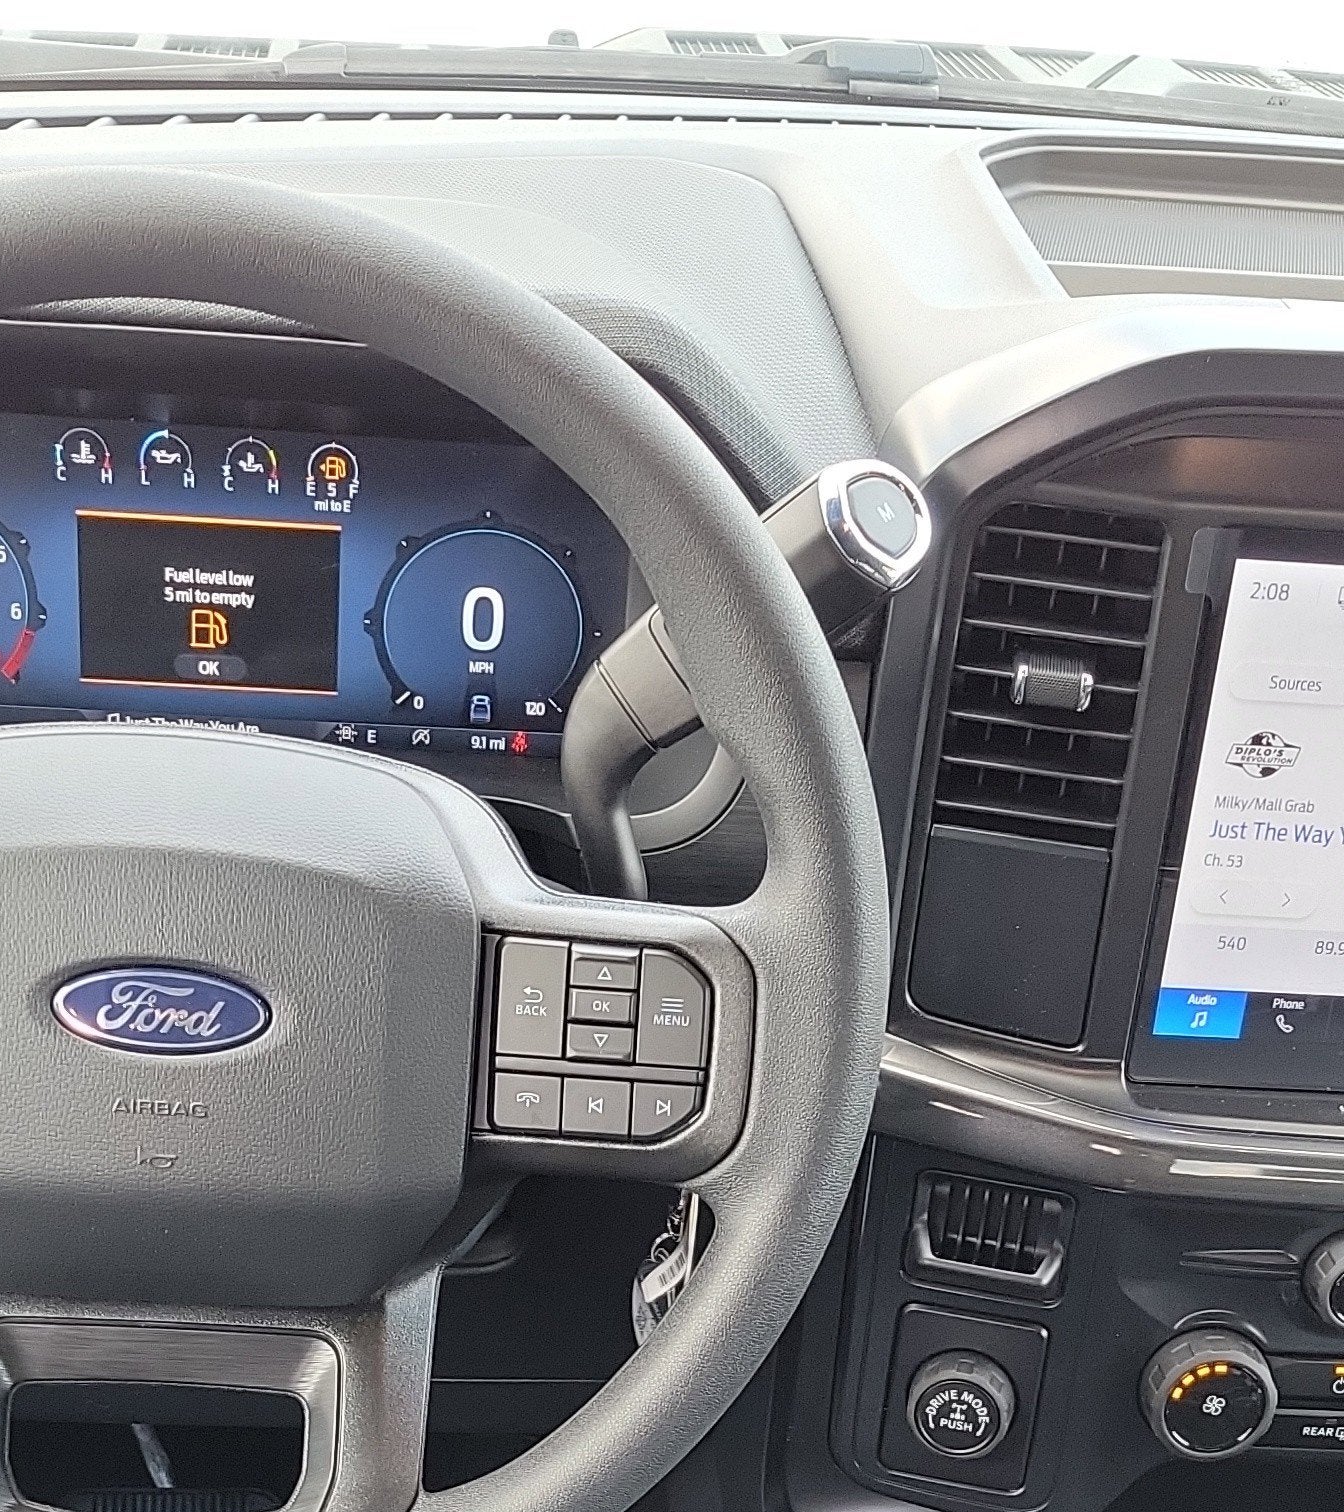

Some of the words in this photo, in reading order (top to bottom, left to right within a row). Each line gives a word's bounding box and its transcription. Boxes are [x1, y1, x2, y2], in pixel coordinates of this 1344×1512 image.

[101, 469, 113, 484] H
[183, 472, 195, 488] H
[268, 479, 279, 494] H
[164, 566, 194, 585] Fuel
[195, 568, 227, 586] level
[228, 570, 255, 588] low
[163, 586, 174, 602] 5
[175, 588, 193, 603] mi
[194, 589, 211, 604] to
[211, 591, 255, 609] empty
[1249, 581, 1290, 602] 2:08
[10, 602, 22, 620] 6
[461, 586, 504, 652] 0
[198, 660, 220, 676] OK
[469, 661, 494, 675] MPH
[1268, 675, 1322, 693] Sources
[413, 695, 424, 710] 0
[525, 701, 545, 716] 120
[367, 729, 377, 744] E
[471, 735, 487, 750] 9.1
[489, 737, 505, 750] mi
[1234, 745, 1286, 758] DIPLO'S
[1239, 755, 1293, 765] REVOLUTION
[1214, 795, 1283, 812] Milky/Mall
[1284, 798, 1315, 814] Grab
[1209, 819, 1248, 841] Just
[1253, 821, 1288, 843] The
[1293, 823, 1334, 848] Way
[1204, 853, 1224, 867] Ch.
[1226, 854, 1243, 868] 53
[1217, 935, 1247, 951] 540
[592, 1000, 610, 1013] OK
[1187, 993, 1218, 1006] Audio
[1272, 997, 1305, 1011] Phone
[96, 980, 226, 1038] Ford
[515, 1004, 547, 1017] BACK
[653, 1013, 690, 1027] MENU
[111, 1097, 208, 1118] AIRBAG
[925, 1389, 959, 1416] DRIVE
[960, 1391, 990, 1424] MODE
[939, 1417, 973, 1432] PUSH
[1302, 1426, 1335, 1437] REAR
